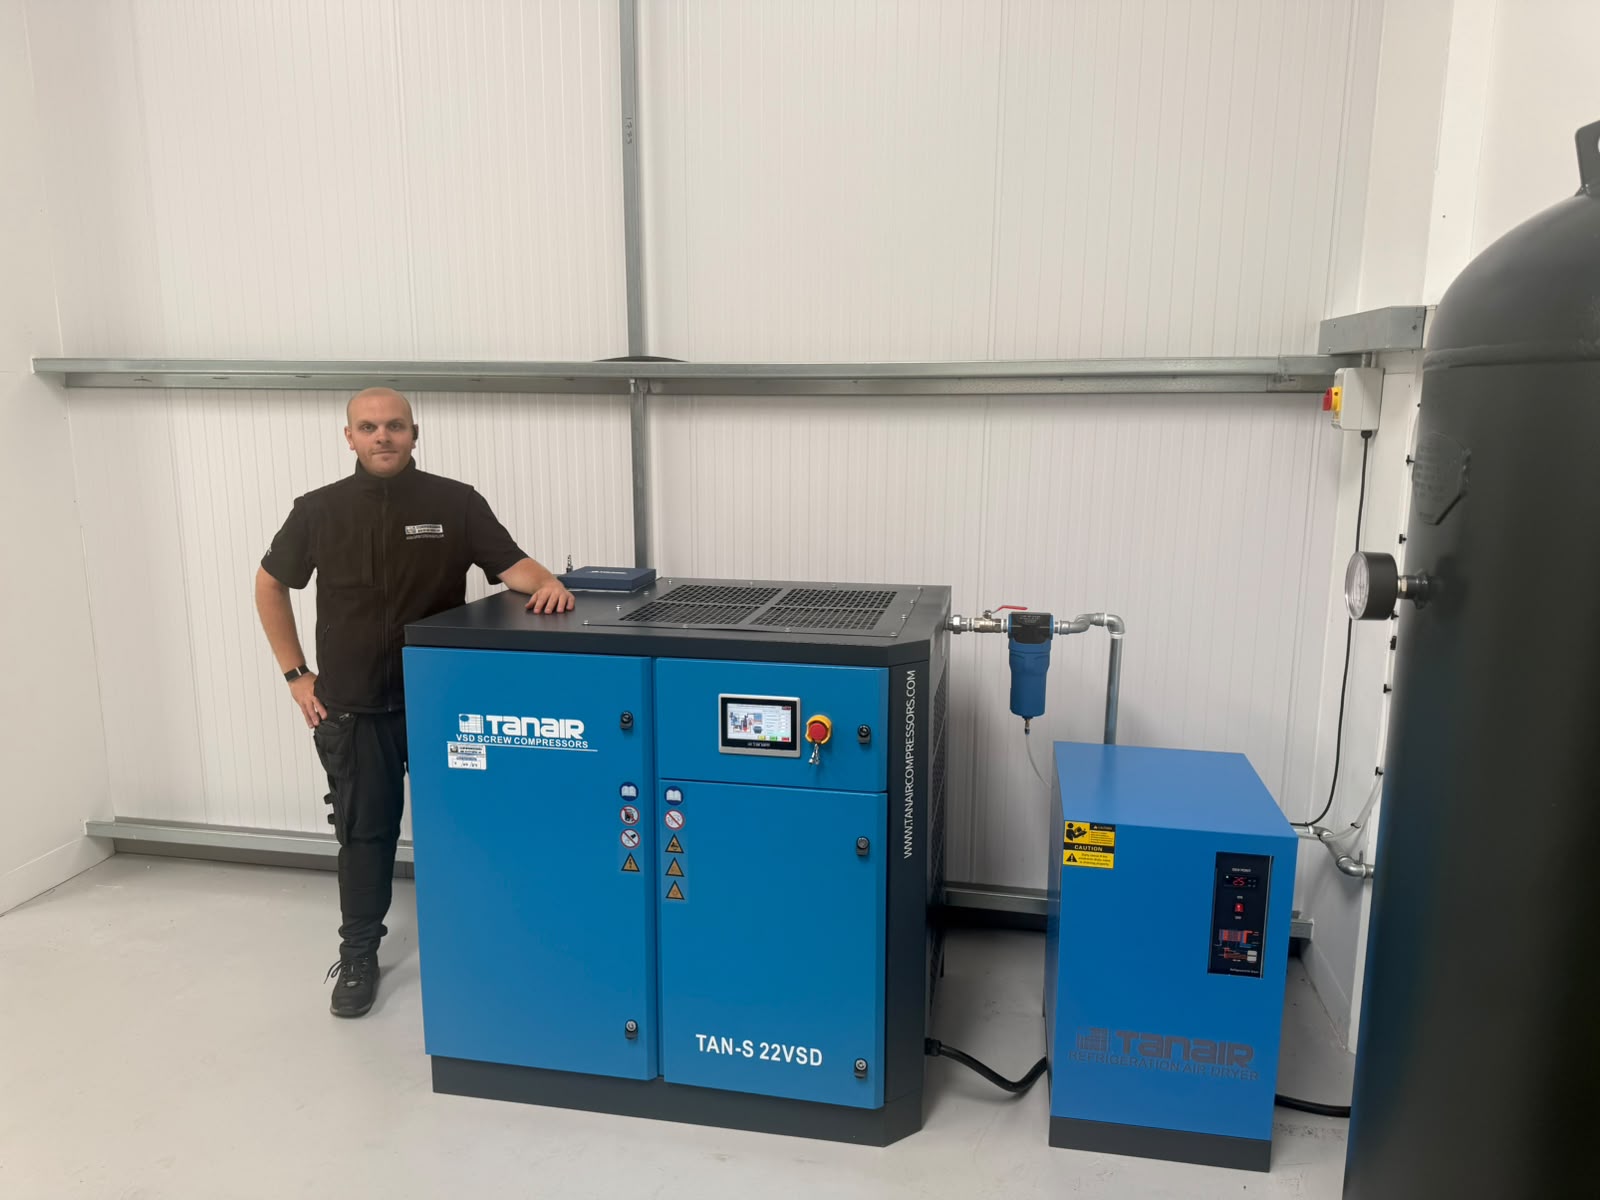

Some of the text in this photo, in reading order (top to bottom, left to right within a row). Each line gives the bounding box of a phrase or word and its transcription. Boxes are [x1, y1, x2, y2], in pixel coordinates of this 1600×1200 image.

[456, 733, 589, 749] VSD SCREW COMPRESSORS
[904, 669, 916, 859] WWW.TANAIRCOMPRESSORS.COM
[1074, 844, 1104, 852] CAUTION
[695, 1033, 823, 1067] TAN-S 22VSD
[1068, 1050, 1260, 1082] REFRIGERATION AIR DRYER
